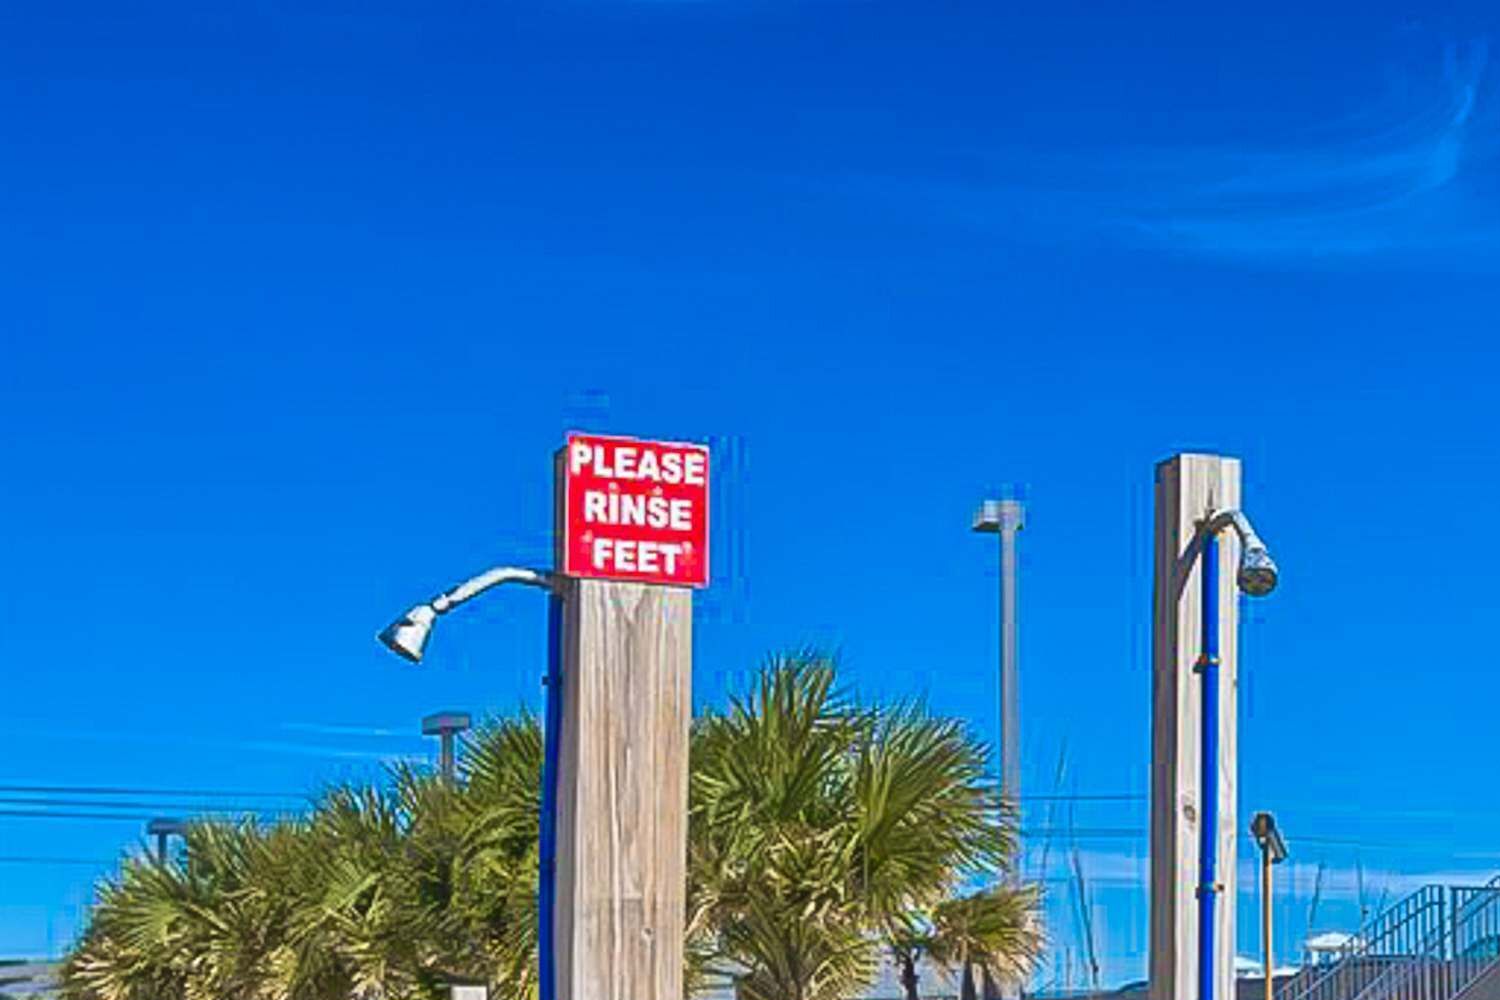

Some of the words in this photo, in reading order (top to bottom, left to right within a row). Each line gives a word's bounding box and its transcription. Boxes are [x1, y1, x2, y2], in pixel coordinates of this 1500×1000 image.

[570, 443, 705, 485] PLEASE
[584, 490, 692, 531] RINSE
[592, 538, 683, 575] FEET
